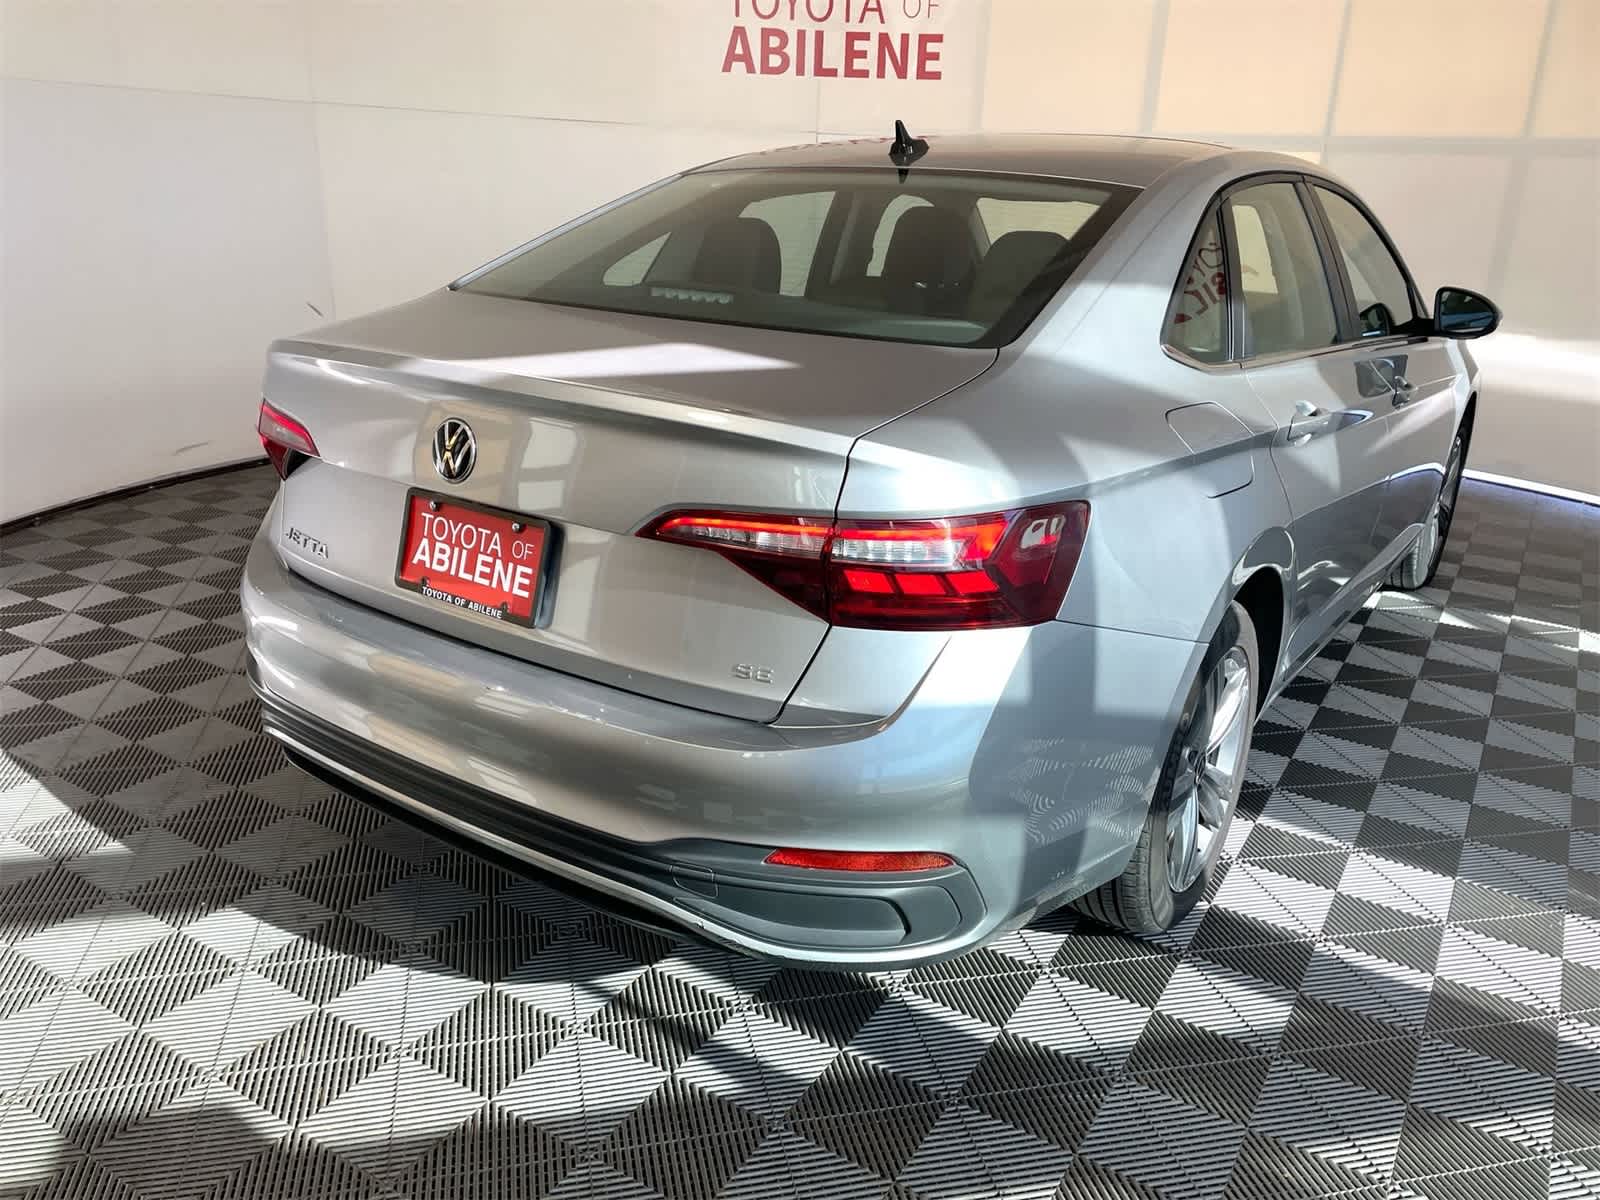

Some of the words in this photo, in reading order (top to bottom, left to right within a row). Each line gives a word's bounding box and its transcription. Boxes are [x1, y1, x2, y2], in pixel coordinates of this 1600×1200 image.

[721, 25, 944, 80] ABILENE
[285, 527, 329, 559] JETTA
[421, 512, 502, 557] TOYOTA
[511, 540, 535, 560] OF
[412, 538, 533, 598] ABILENE
[422, 586, 452, 603] TOYOTA
[454, 597, 466, 607] OF
[468, 601, 503, 619] ABILENE
[733, 664, 774, 684] SE
